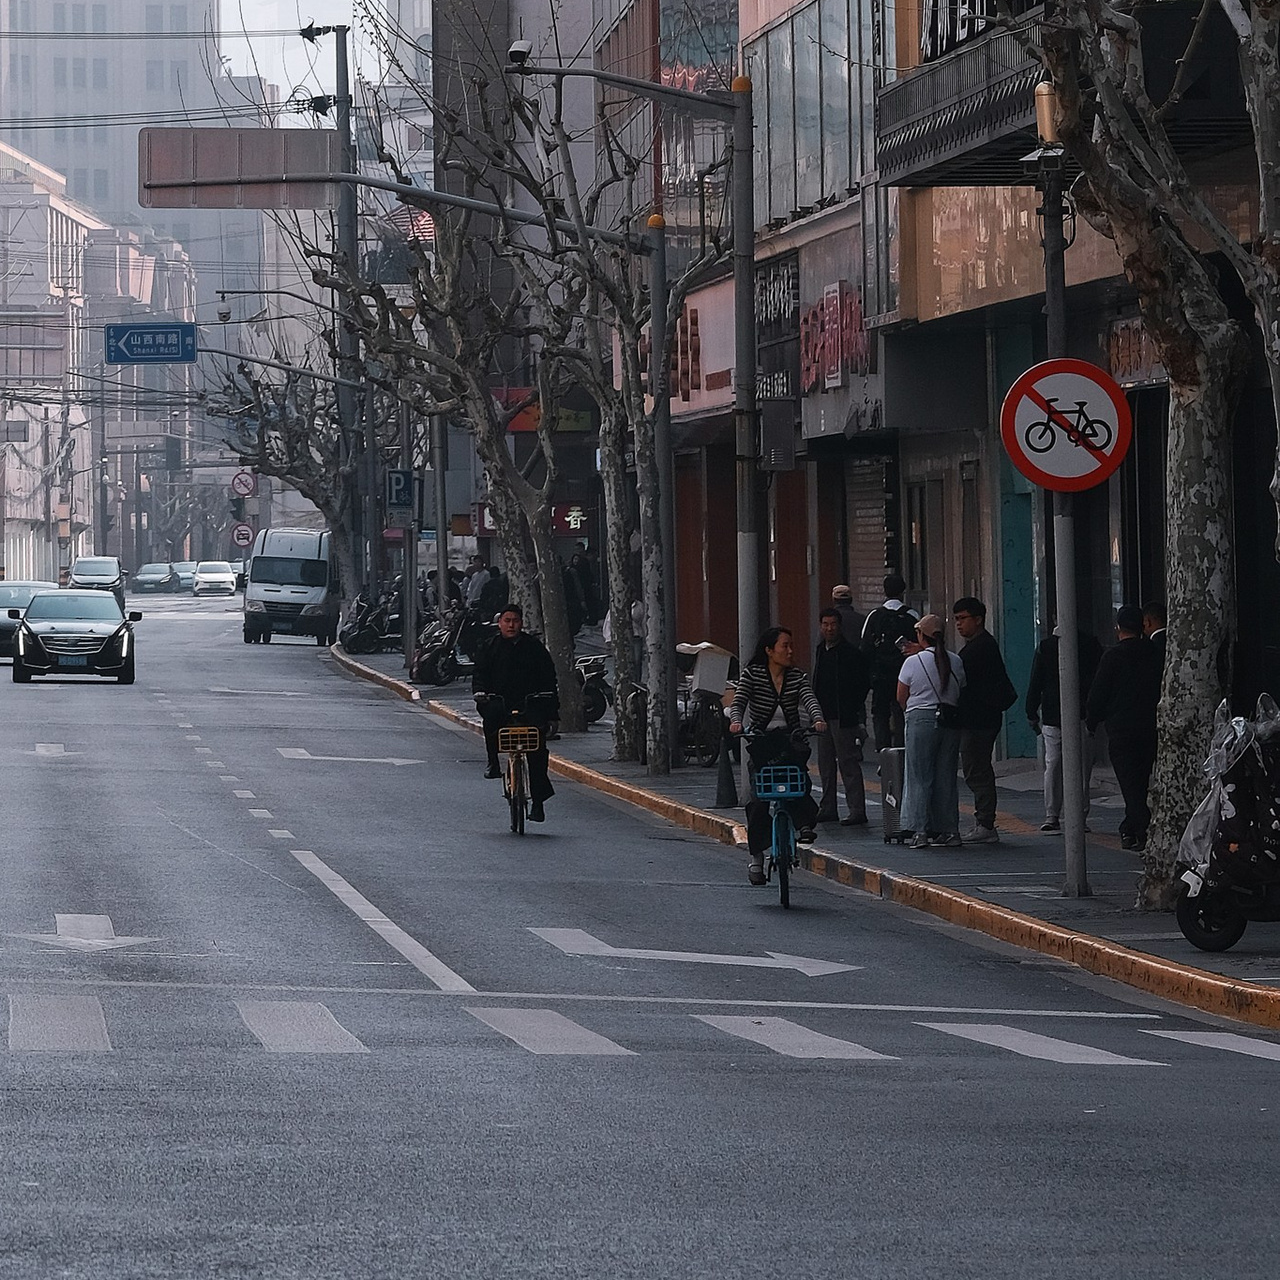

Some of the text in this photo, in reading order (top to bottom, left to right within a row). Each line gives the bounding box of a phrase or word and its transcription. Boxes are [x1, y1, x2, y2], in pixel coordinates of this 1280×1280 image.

[131, 333, 178, 345] 山西南路
[390, 472, 404, 504] P
